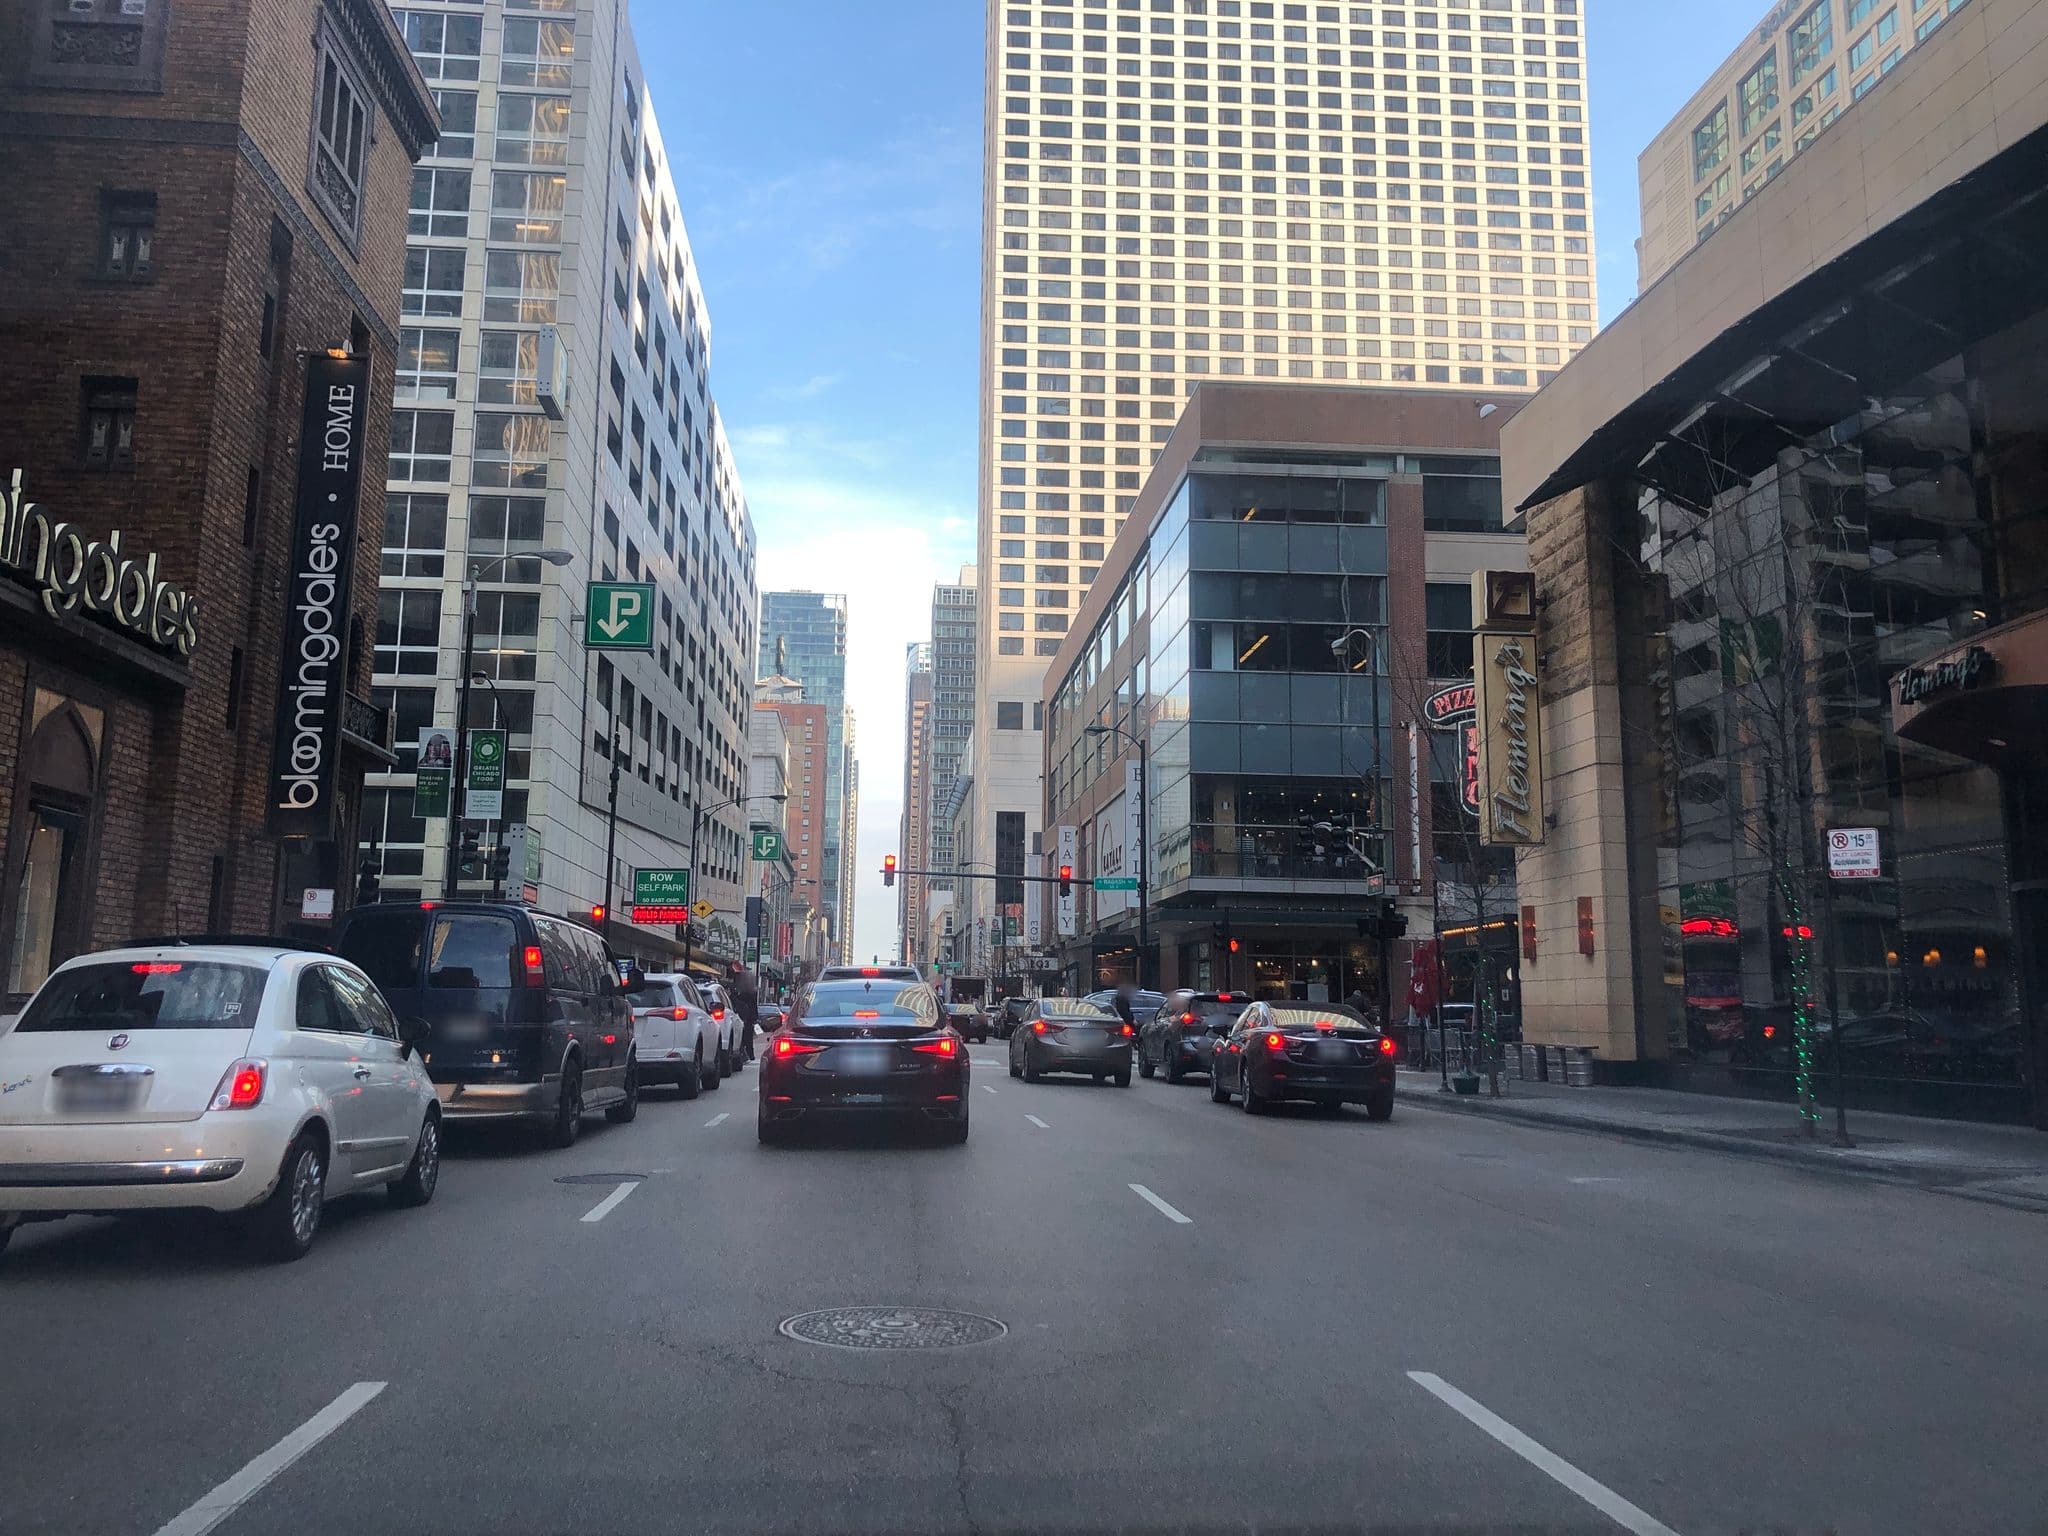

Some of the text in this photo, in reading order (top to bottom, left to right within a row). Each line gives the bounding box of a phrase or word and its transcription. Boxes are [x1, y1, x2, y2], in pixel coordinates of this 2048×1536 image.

[323, 384, 355, 472] HOME
[0, 468, 199, 656] ingdale's
[638, 883, 685, 892] SELF PARK
[650, 873, 674, 882] ROW
[1062, 831, 1073, 928] EALY
